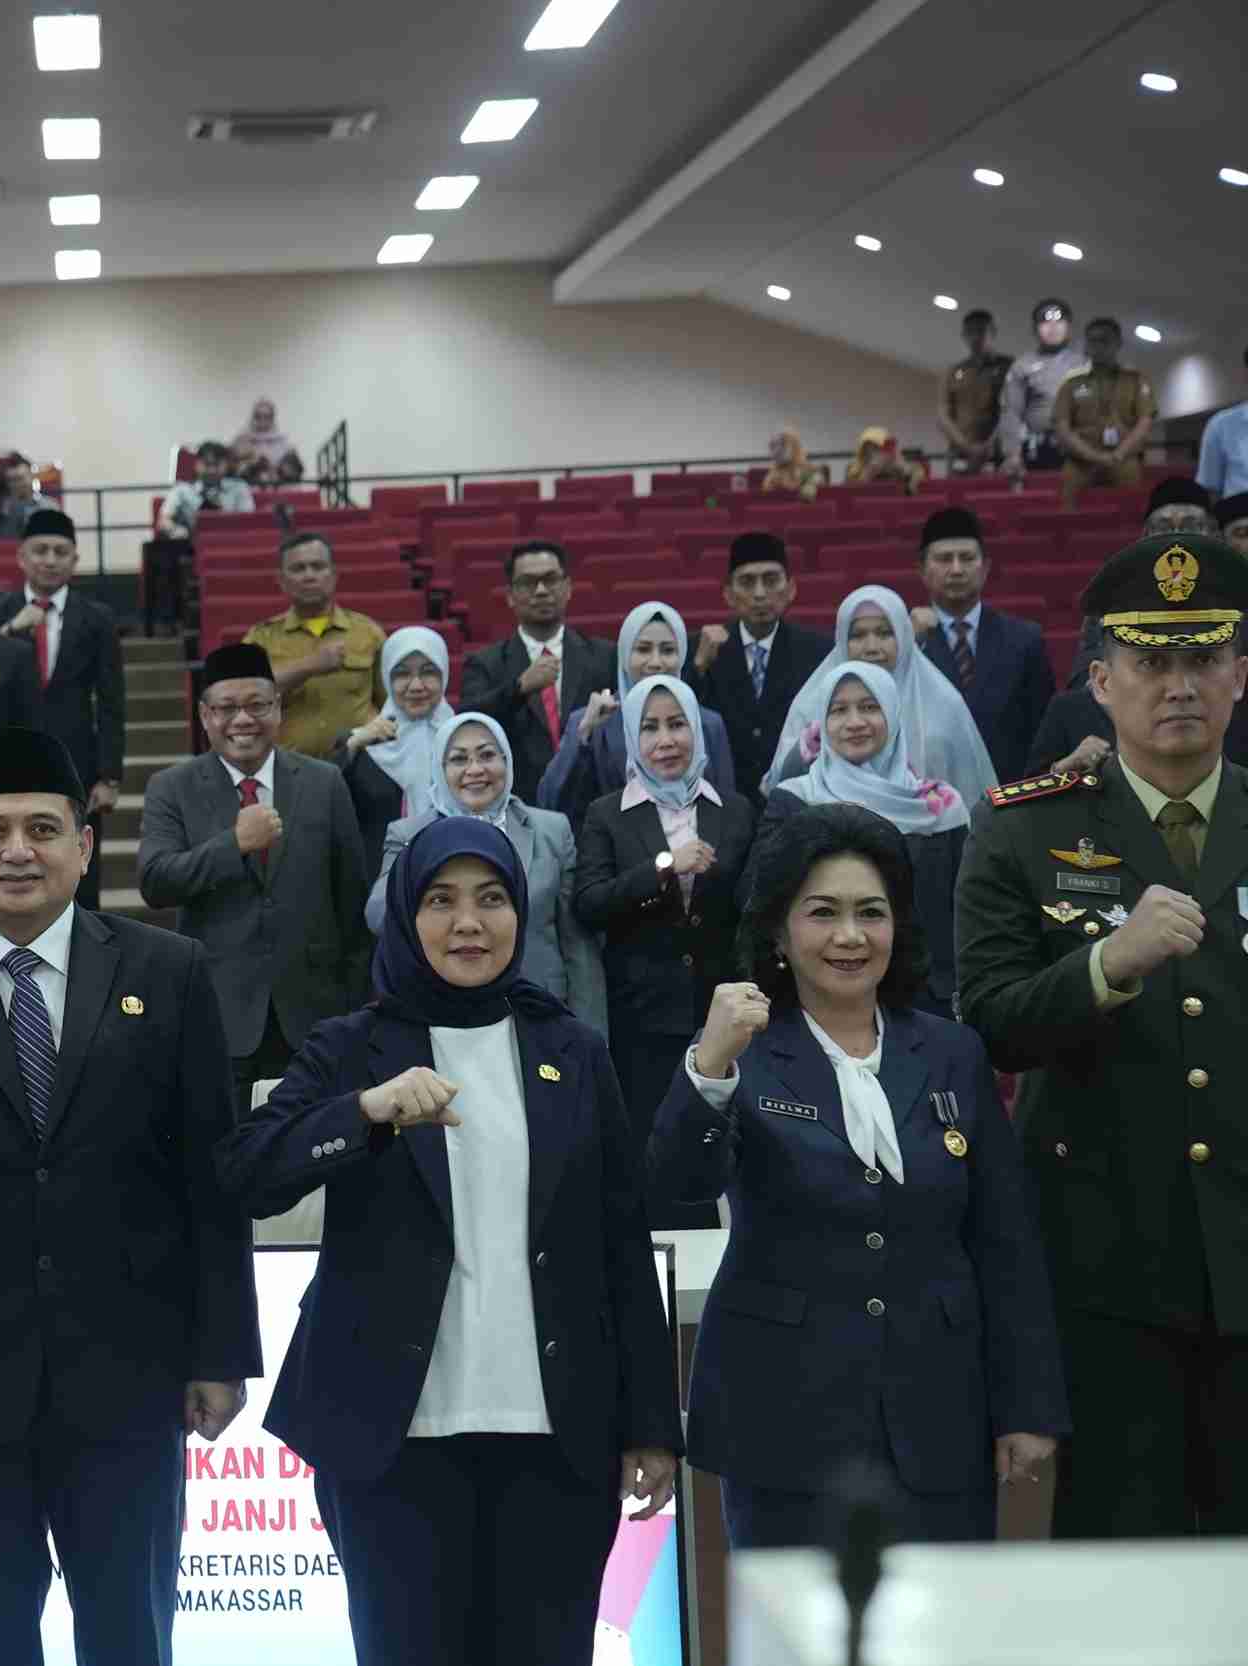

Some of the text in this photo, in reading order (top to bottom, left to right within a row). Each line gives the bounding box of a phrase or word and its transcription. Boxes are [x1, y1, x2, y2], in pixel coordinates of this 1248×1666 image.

[201, 1498, 297, 1532] JANJI
[294, 1553, 340, 1576] DAE
[175, 1588, 304, 1612] MAKASSAR
